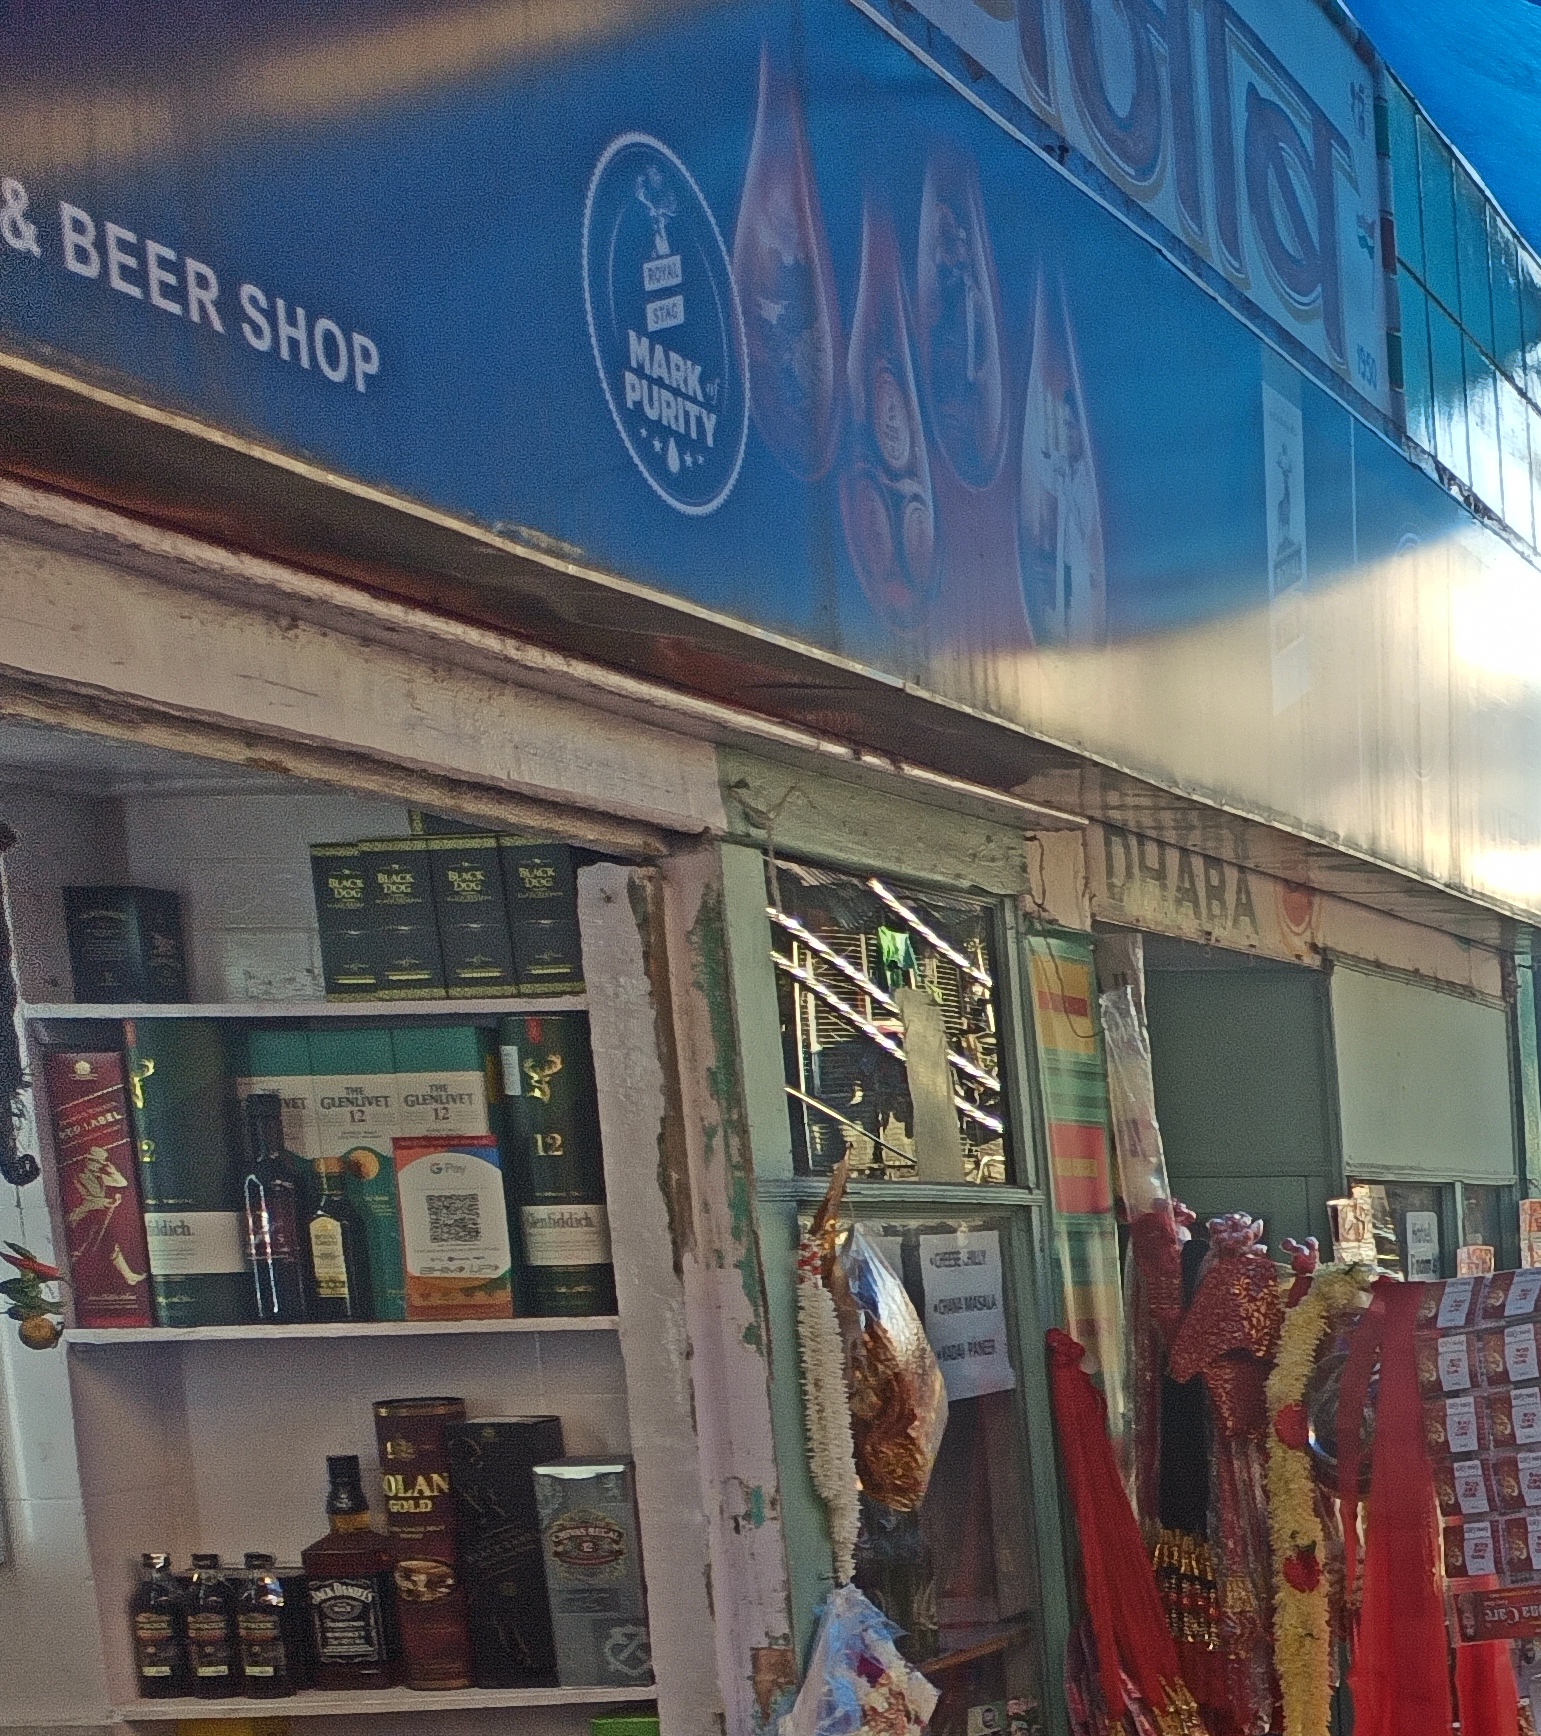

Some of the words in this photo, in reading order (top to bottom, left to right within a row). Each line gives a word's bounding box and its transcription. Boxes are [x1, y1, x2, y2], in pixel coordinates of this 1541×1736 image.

[0, 177, 41, 258] &
[60, 201, 225, 334] BEER
[239, 283, 380, 393] SHOP
[628, 329, 704, 402] MARK
[624, 370, 717, 448] PURITY
[377, 873, 414, 885] BLACK
[448, 870, 485, 882] BLACK
[519, 867, 556, 879] BLACK
[328, 877, 365, 890] BLACK
[454, 881, 481, 892] DOG
[524, 877, 553, 888] DOG
[1103, 826, 1259, 936] DHABA
[334, 888, 361, 899] DOG
[383, 884, 411, 895] DOG
[320, 1096, 390, 1110] GLENLIVET
[404, 1093, 473, 1108] GLENLIVET
[350, 1109, 367, 1123] 12
[433, 1107, 450, 1122] 12
[533, 1133, 564, 1156] 12
[383, 1473, 450, 1497] OLAN
[388, 1499, 433, 1513] GOLD
